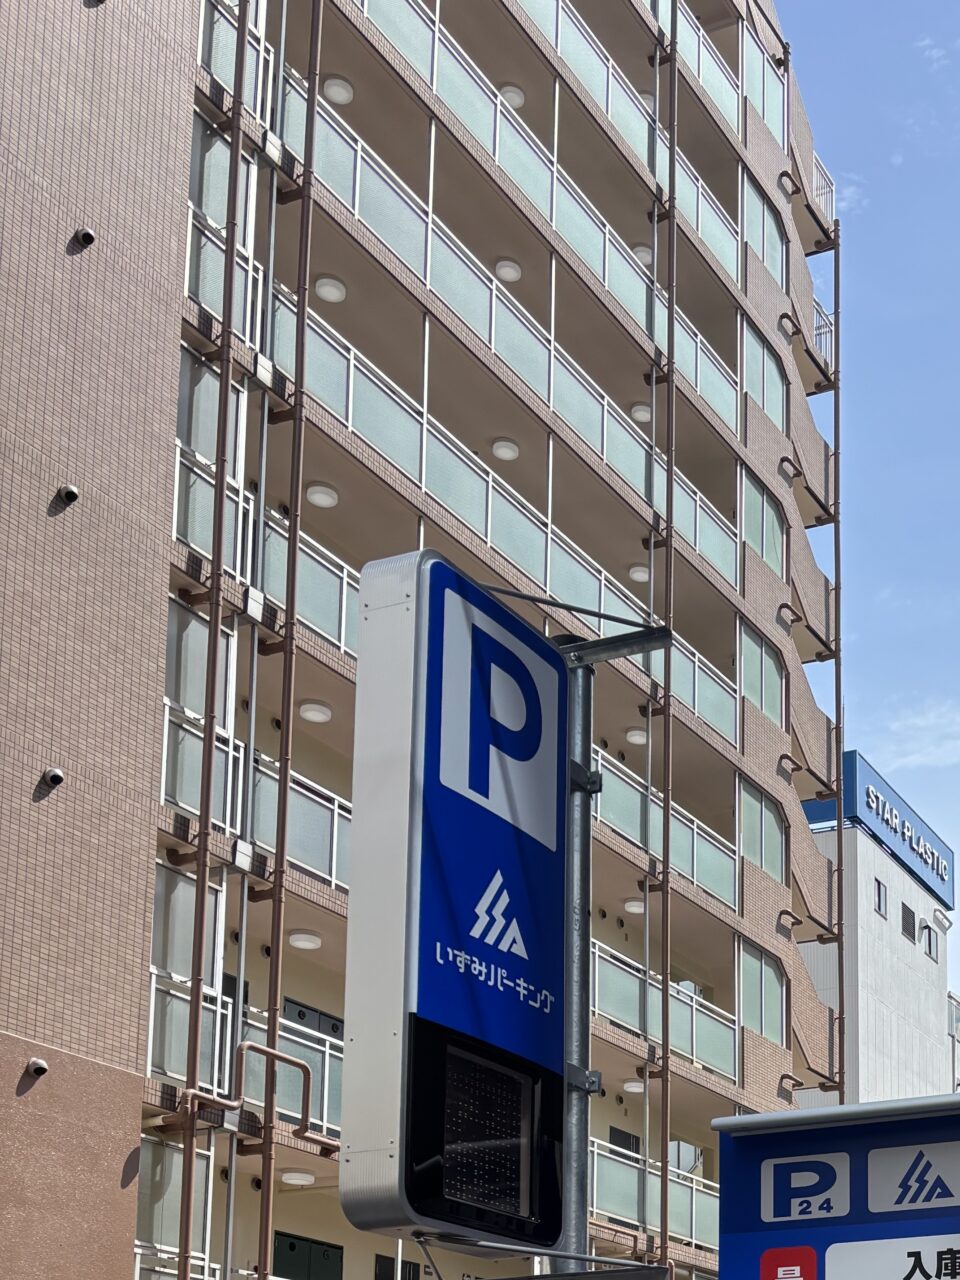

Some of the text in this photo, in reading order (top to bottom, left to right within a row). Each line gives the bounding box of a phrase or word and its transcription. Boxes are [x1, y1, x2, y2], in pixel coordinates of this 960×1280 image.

[468, 622, 543, 800] P
[867, 785, 949, 882] STAR PLASTIC
[436, 941, 555, 1014] いずみパーキング
